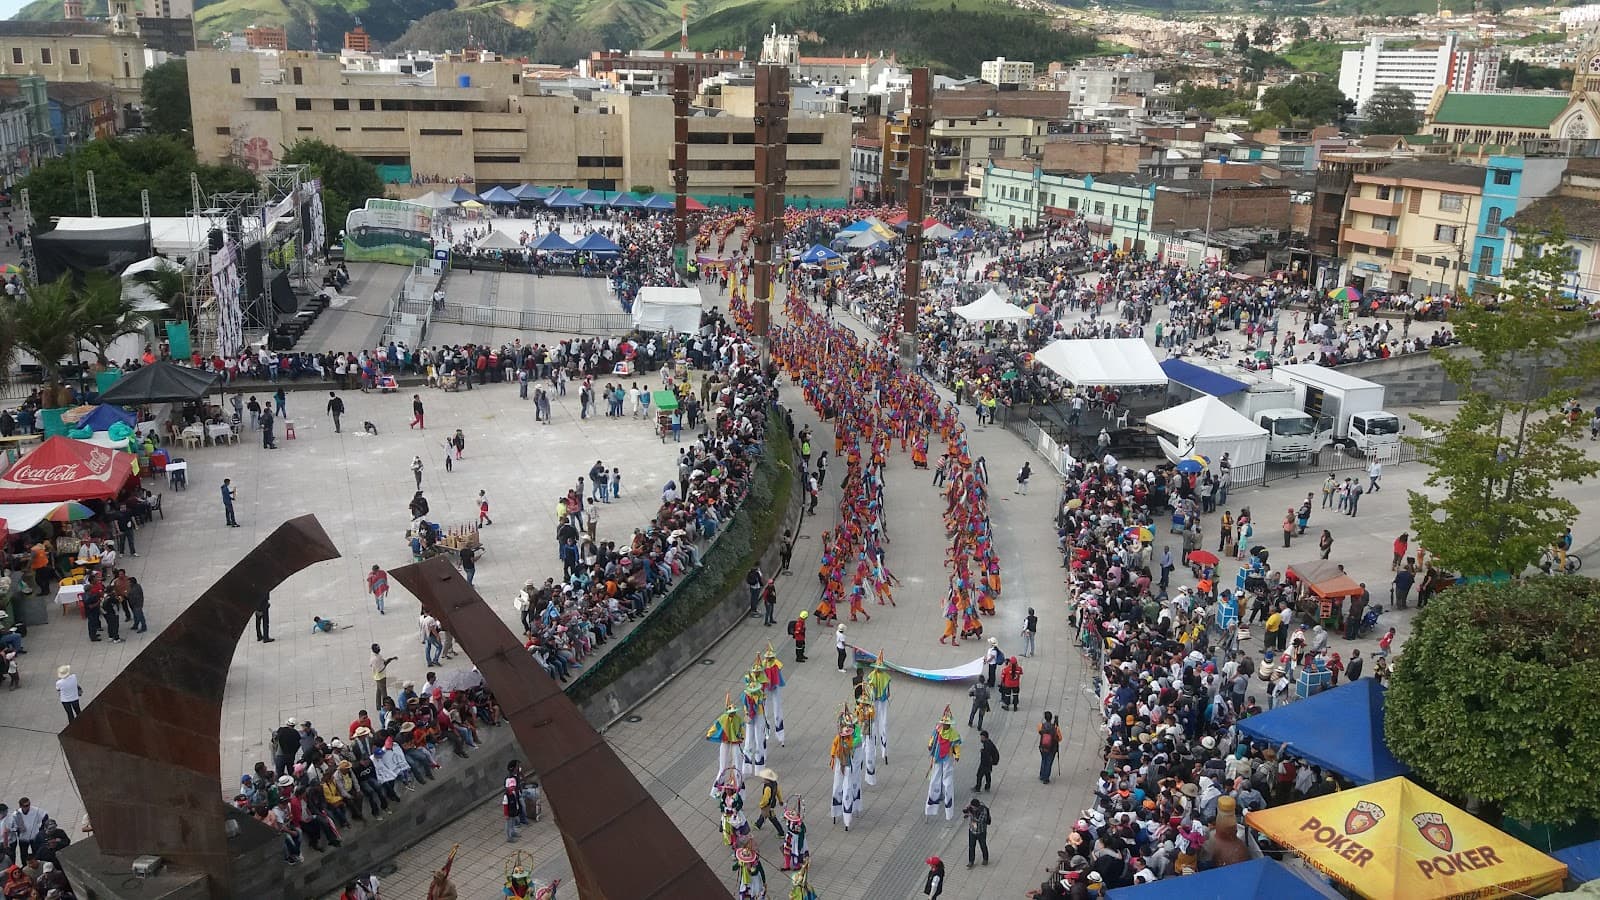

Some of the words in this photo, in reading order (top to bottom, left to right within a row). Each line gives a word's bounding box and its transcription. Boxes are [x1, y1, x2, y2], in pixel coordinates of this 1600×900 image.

[13, 463, 81, 482] Coca-Cola
[1299, 816, 1375, 869] POKER
[1313, 860, 1324, 870] DE
[1416, 845, 1504, 880] POKER
[1484, 886, 1496, 897] DE
